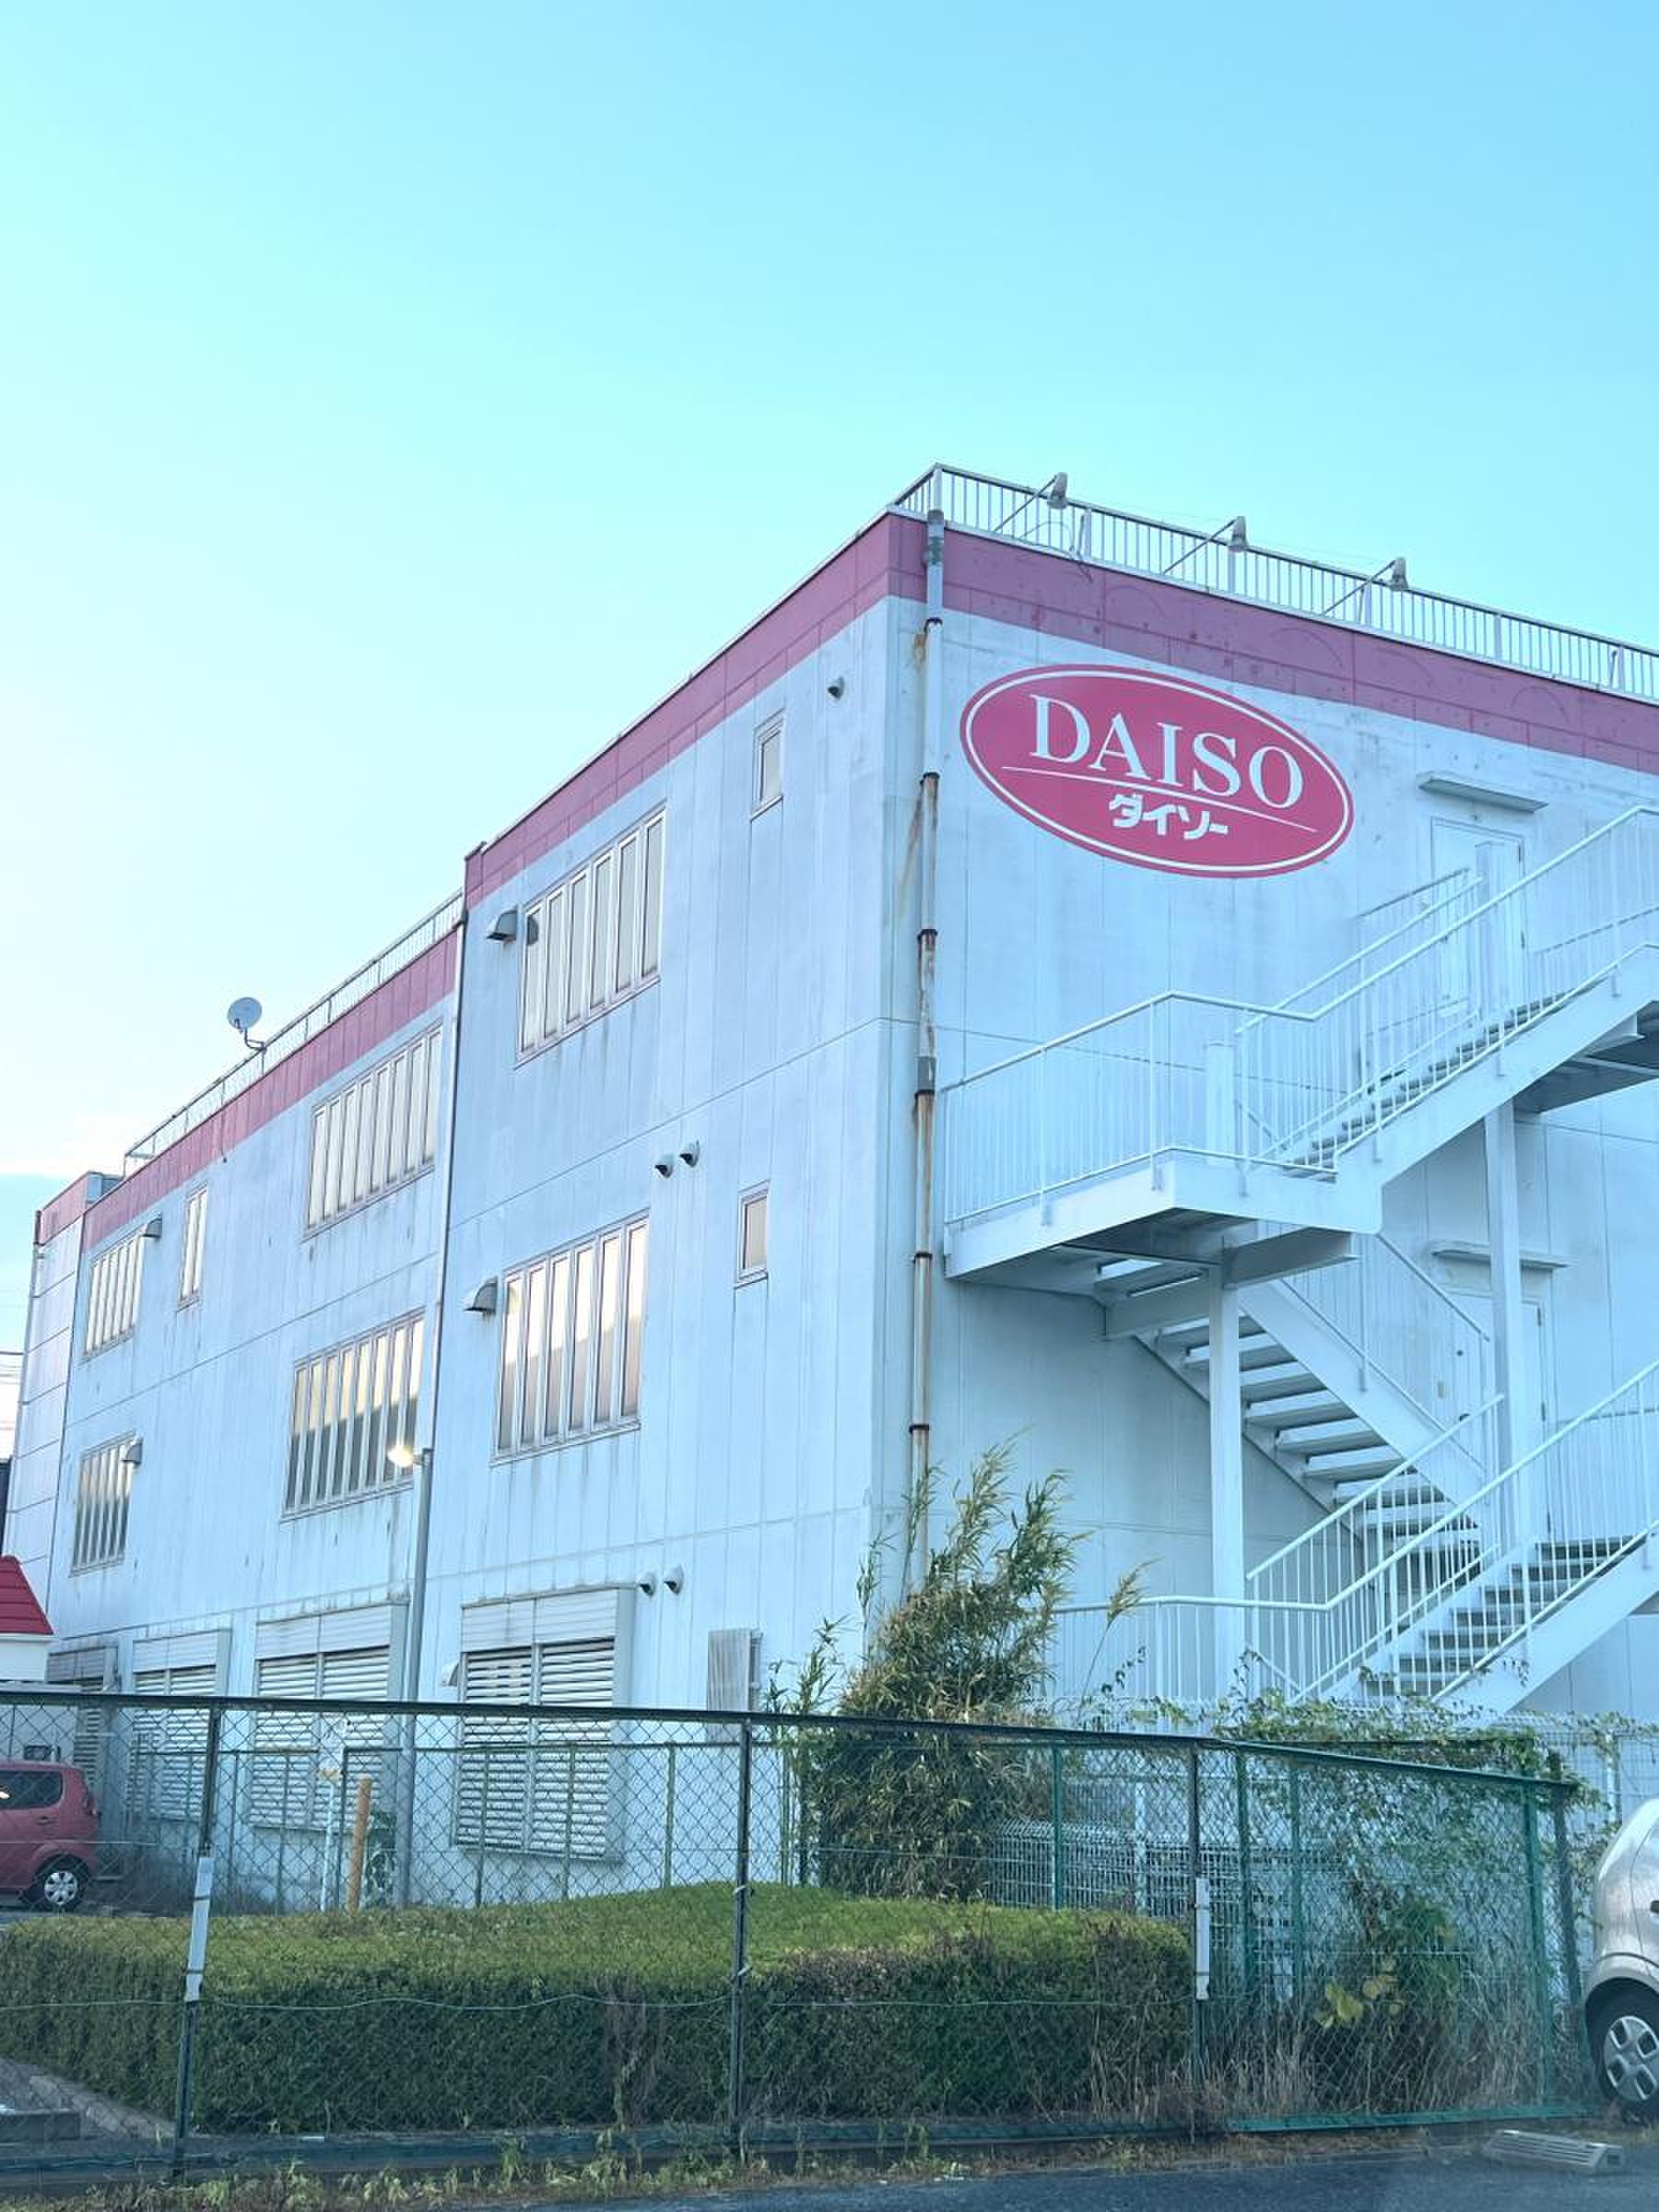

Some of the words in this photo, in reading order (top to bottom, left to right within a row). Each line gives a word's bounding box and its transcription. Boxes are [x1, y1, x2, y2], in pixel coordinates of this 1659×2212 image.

[1029, 694, 1304, 809] DAISO
[1109, 793, 1229, 841] ダイソー
